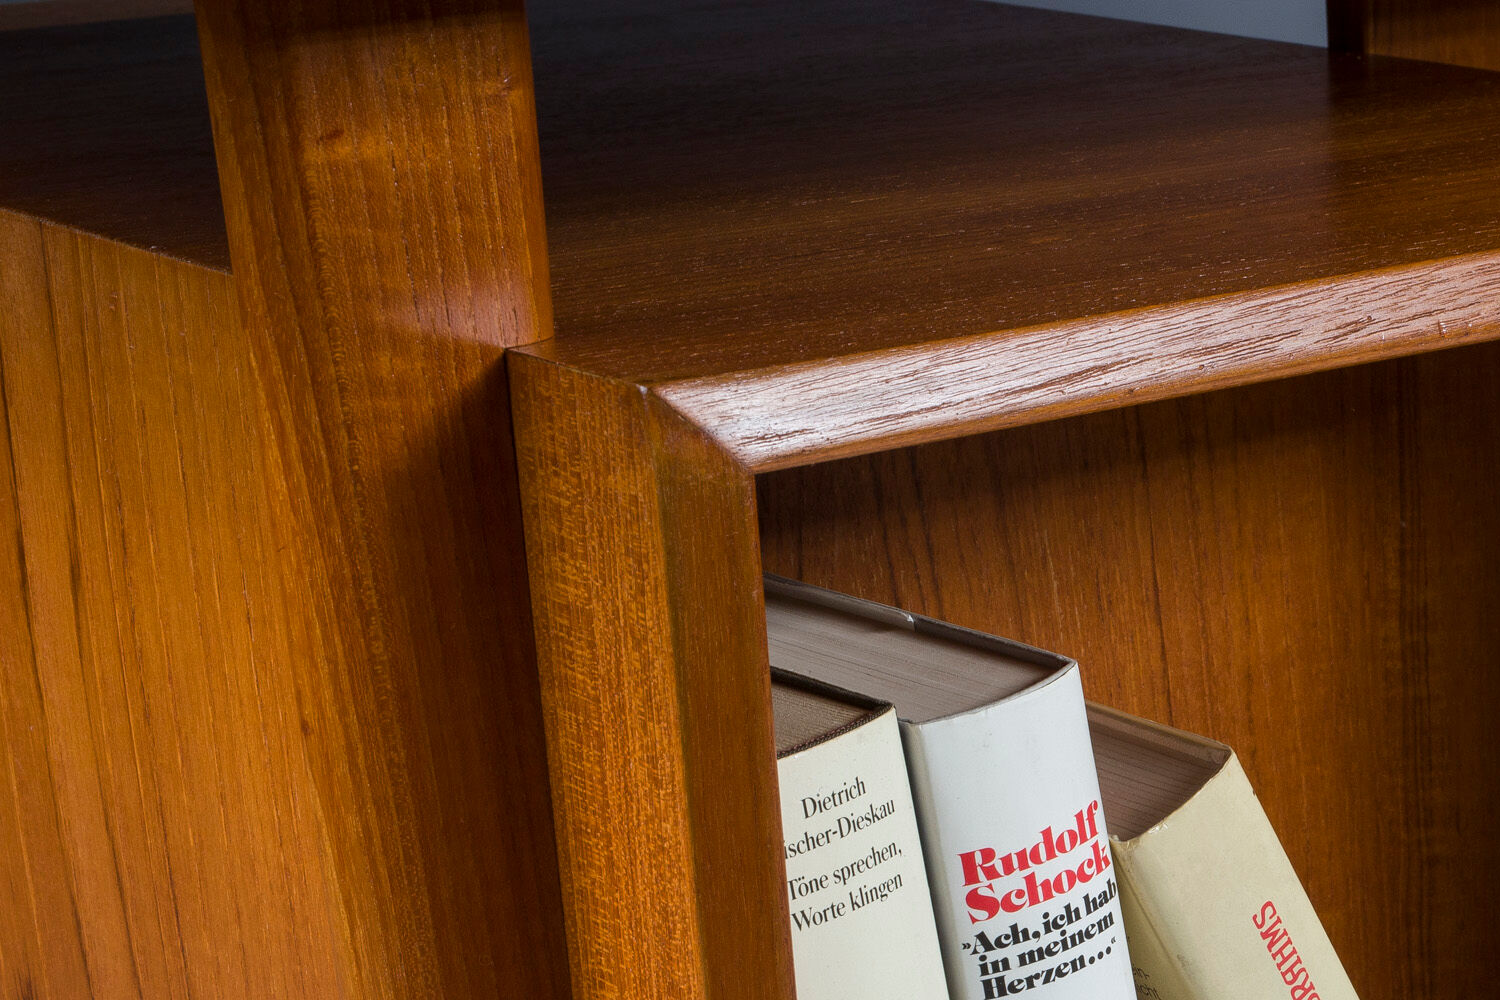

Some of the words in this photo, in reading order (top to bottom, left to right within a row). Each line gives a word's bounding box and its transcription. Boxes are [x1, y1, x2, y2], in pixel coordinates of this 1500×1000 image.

[801, 776, 867, 819] Dietrich
[784, 800, 896, 860] ischer-Dieskau
[957, 800, 1099, 887] Rudolf
[787, 874, 830, 901] Töne
[833, 842, 903, 886] sprechen,
[965, 839, 1111, 925] Schock
[792, 901, 847, 932] Worte
[849, 873, 904, 912] klingen
[1042, 902, 1082, 936] ich
[1083, 878, 1118, 917] hab
[978, 954, 1012, 977] in
[1017, 911, 1115, 968] meinem
